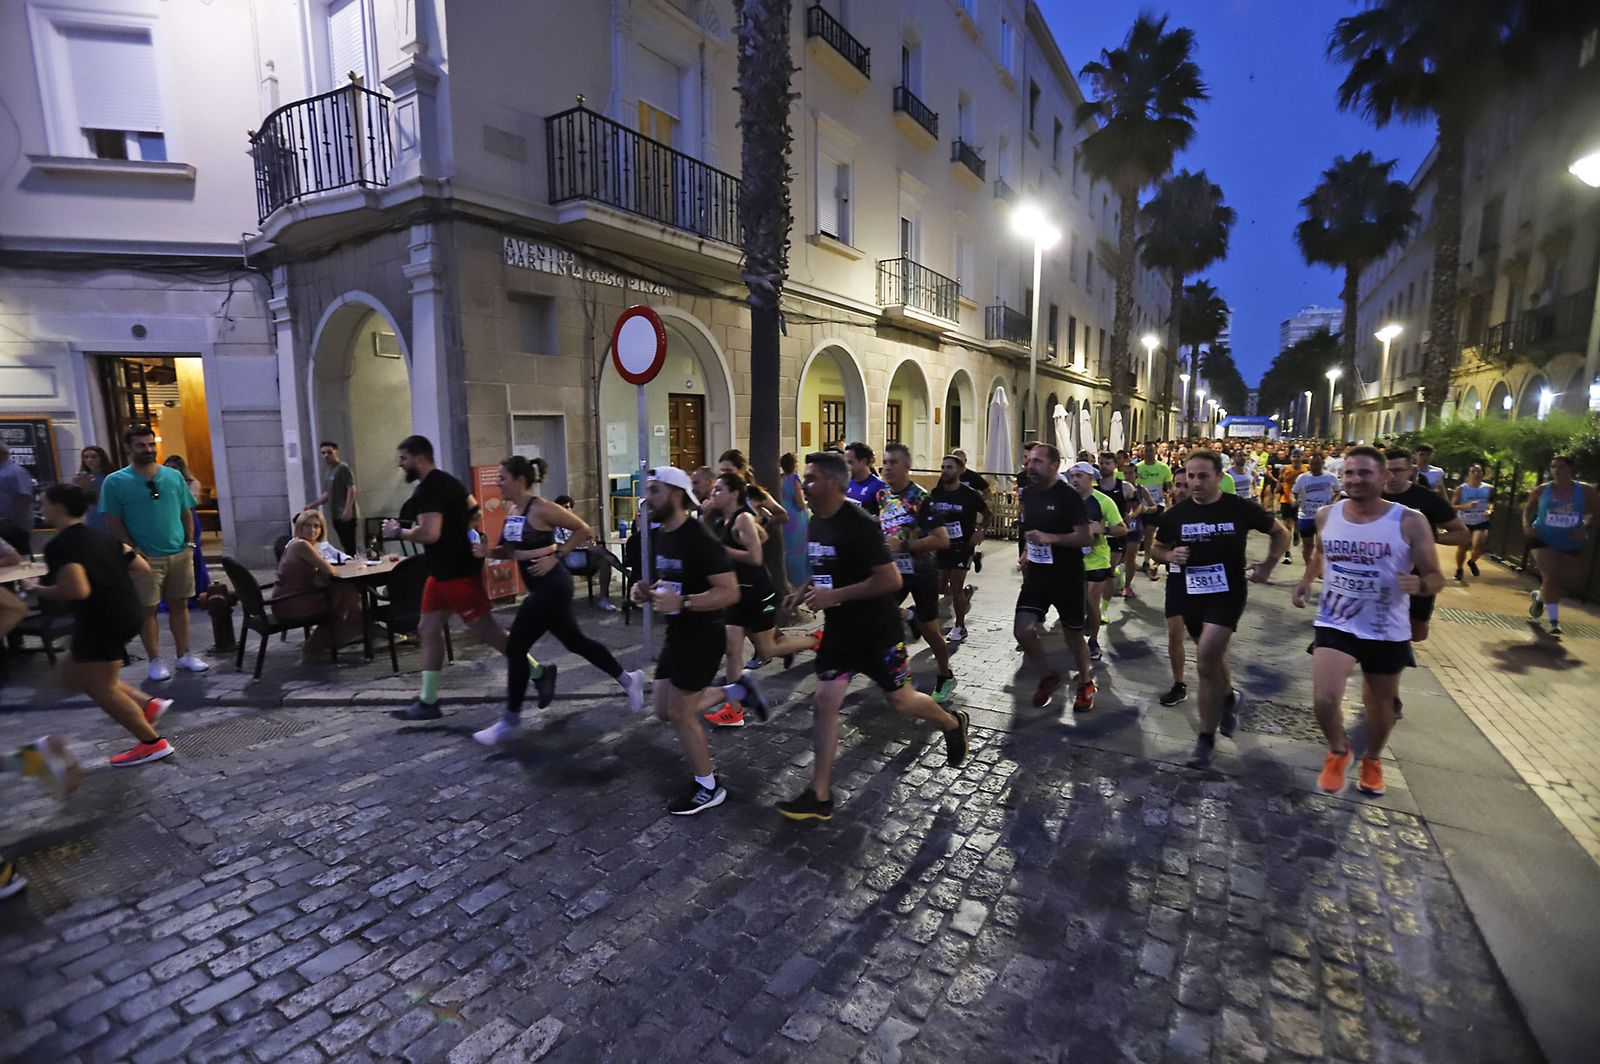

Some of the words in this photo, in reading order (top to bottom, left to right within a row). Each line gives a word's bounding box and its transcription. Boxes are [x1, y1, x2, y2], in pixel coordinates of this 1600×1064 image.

[504, 238, 574, 264] AVENIDA
[504, 251, 567, 276] MARTIN
[1200, 523, 1216, 534] FOR
[1217, 522, 1234, 533] FUN
[1195, 576, 1214, 587] 581
[1342, 577, 1365, 591] 792
